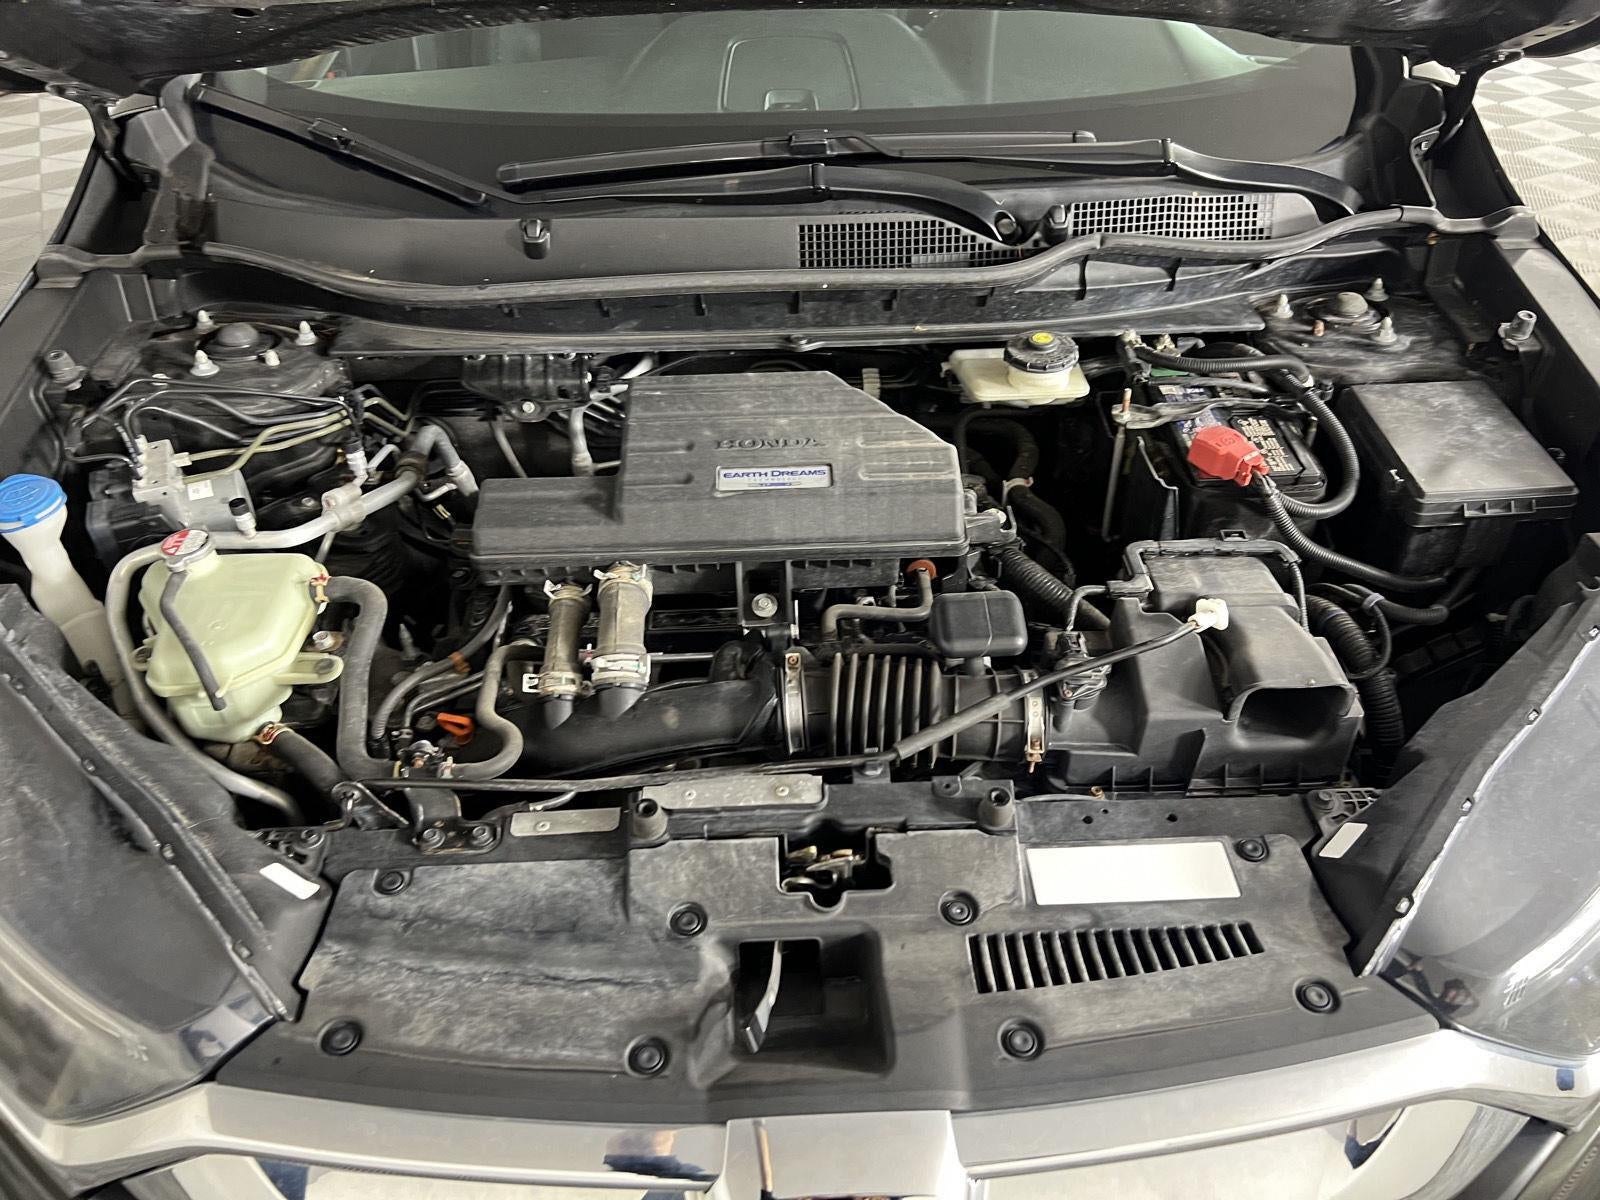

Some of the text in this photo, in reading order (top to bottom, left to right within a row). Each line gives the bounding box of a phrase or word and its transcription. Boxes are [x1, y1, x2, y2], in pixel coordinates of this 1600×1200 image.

[714, 438, 826, 450] HONDA
[723, 469, 826, 479] EARTH DREAMS
